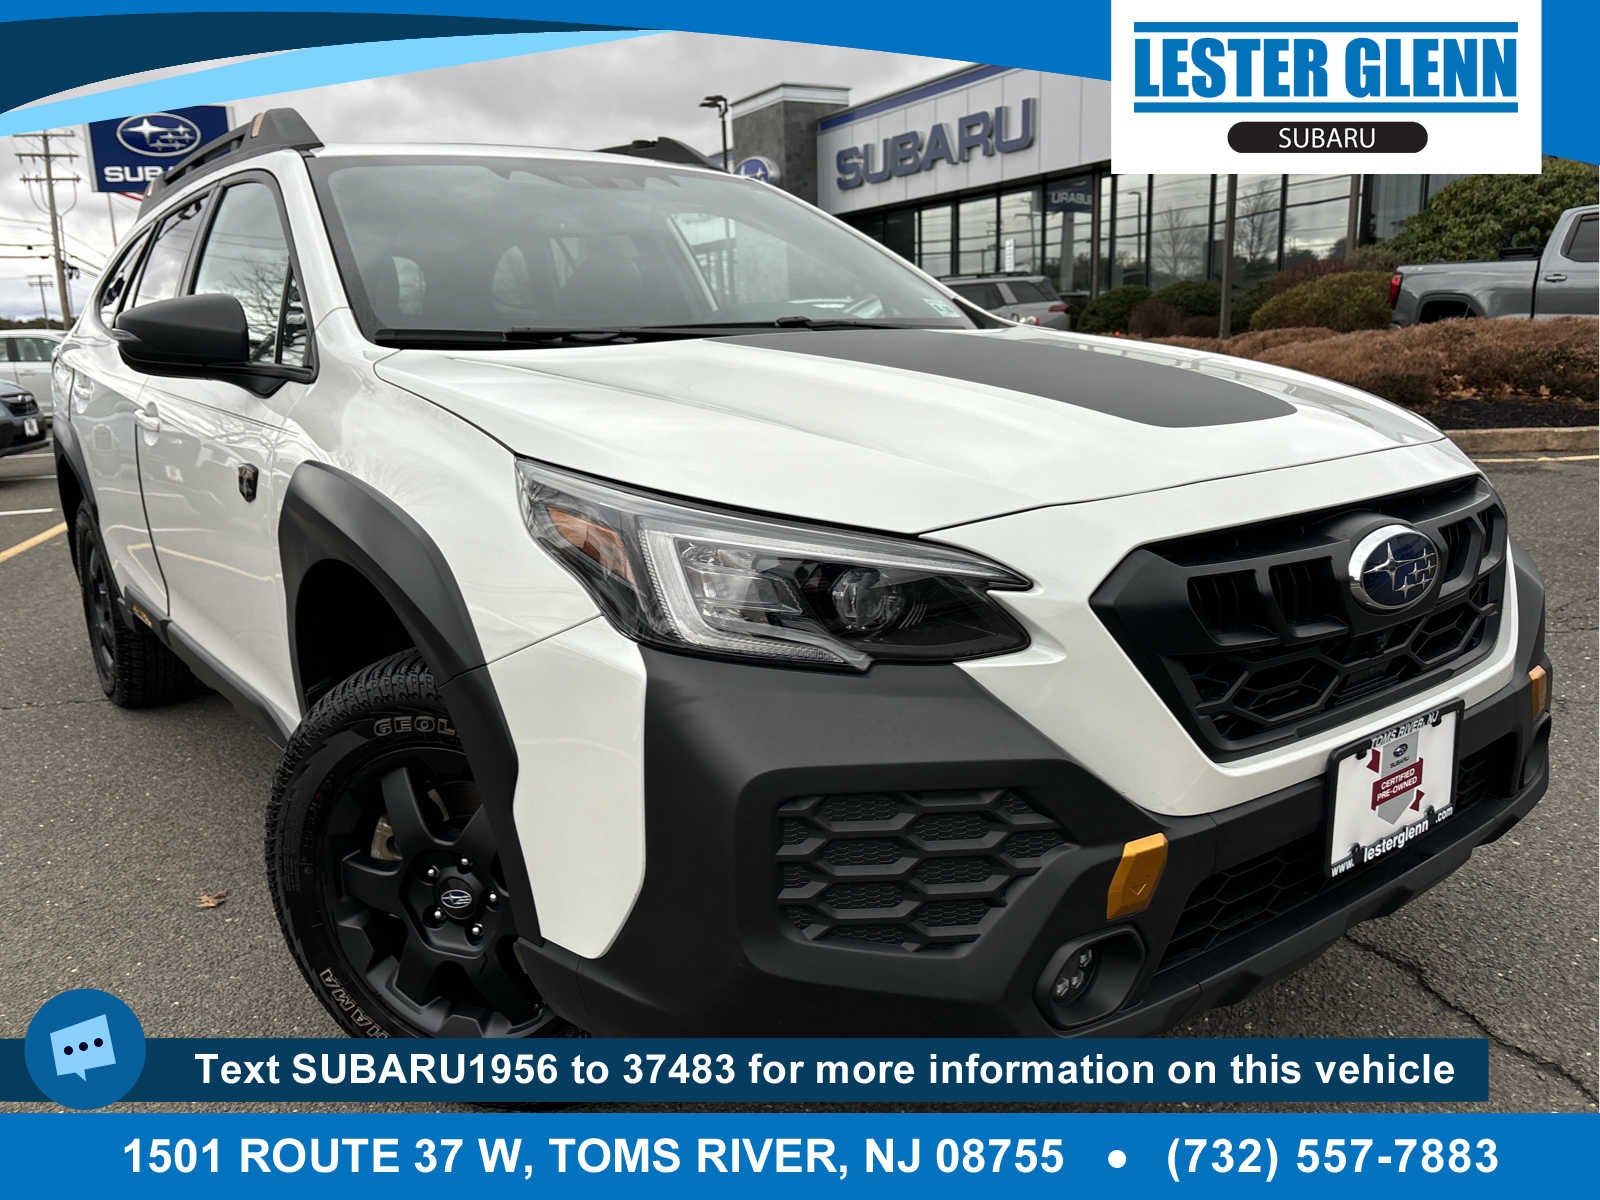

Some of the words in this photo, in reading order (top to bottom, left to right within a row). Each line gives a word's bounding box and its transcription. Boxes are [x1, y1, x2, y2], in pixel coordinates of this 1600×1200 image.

[836, 98, 1037, 192] SUBARU
[104, 165, 174, 182] SUB
[374, 716, 455, 736] GEOL
[1372, 729, 1398, 748] TOMS
[1377, 776, 1418, 801] PRE-OWNED
[1381, 768, 1415, 790] CERTIFIED
[1363, 819, 1429, 863] lesterglenn
[320, 969, 391, 1038] HAMA
